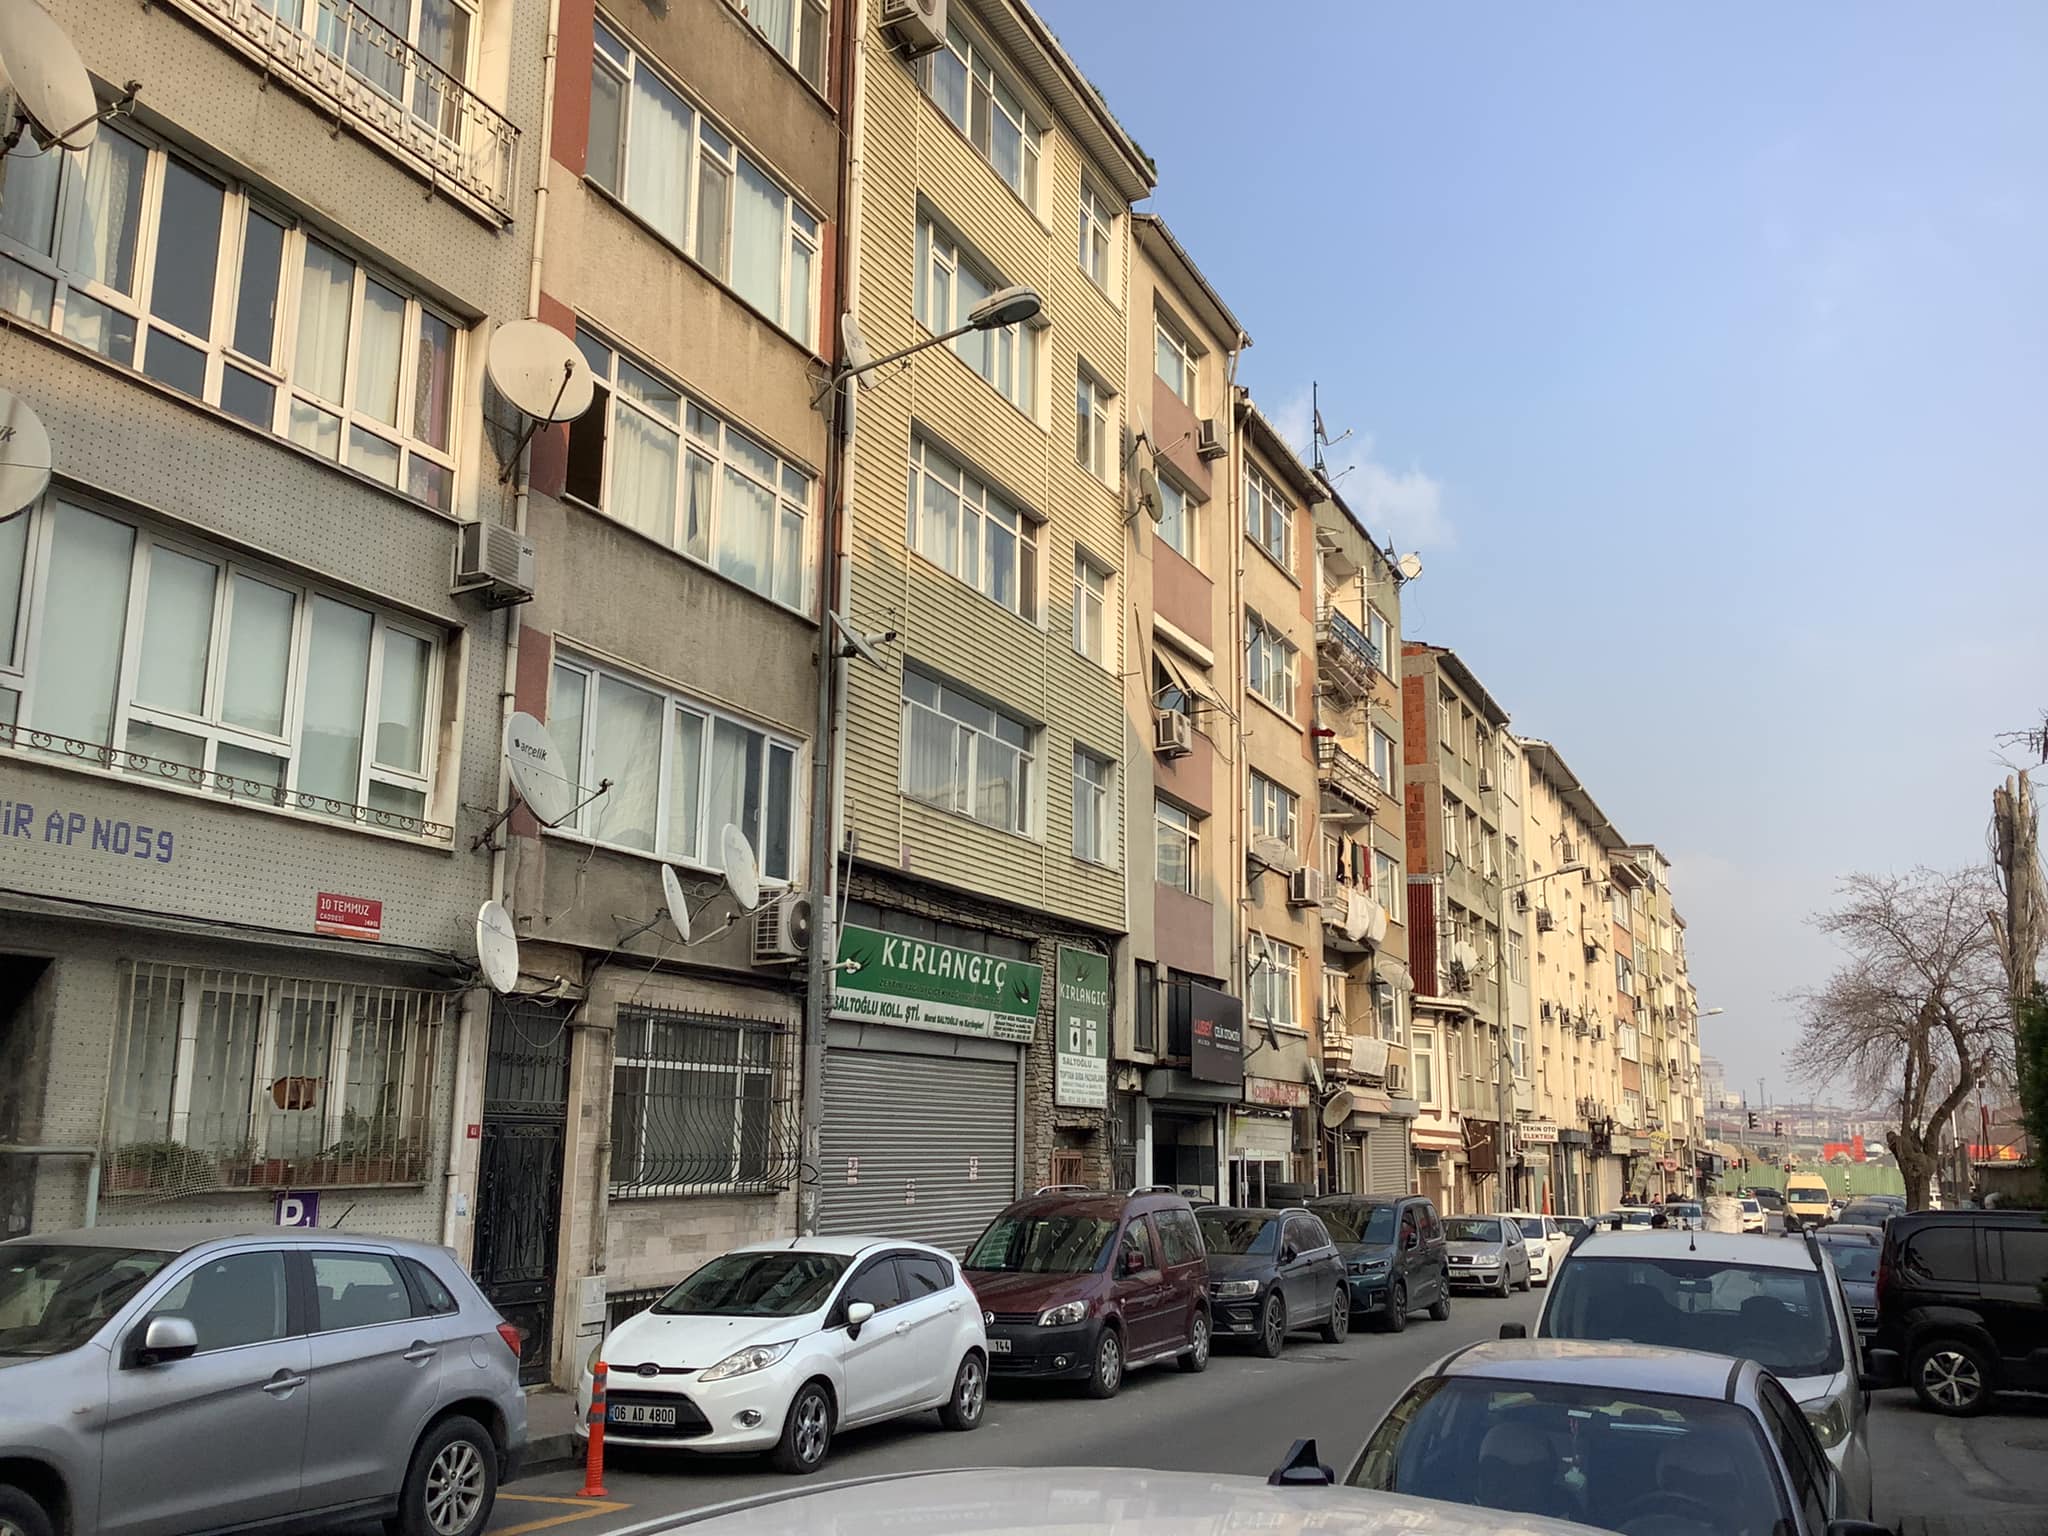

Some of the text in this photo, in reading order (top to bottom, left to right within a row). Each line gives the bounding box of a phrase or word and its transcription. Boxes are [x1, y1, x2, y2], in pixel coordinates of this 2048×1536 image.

[45, 809, 86, 846] AP
[321, 898, 370, 916] 10 TEMMUZ
[881, 937, 1008, 994] KIRLANGIÇ
[1060, 983, 1106, 1009] KIRLANGIÇ
[996, 1340, 1010, 1351] 144
[615, 1406, 674, 1423] 06 AD 4800
